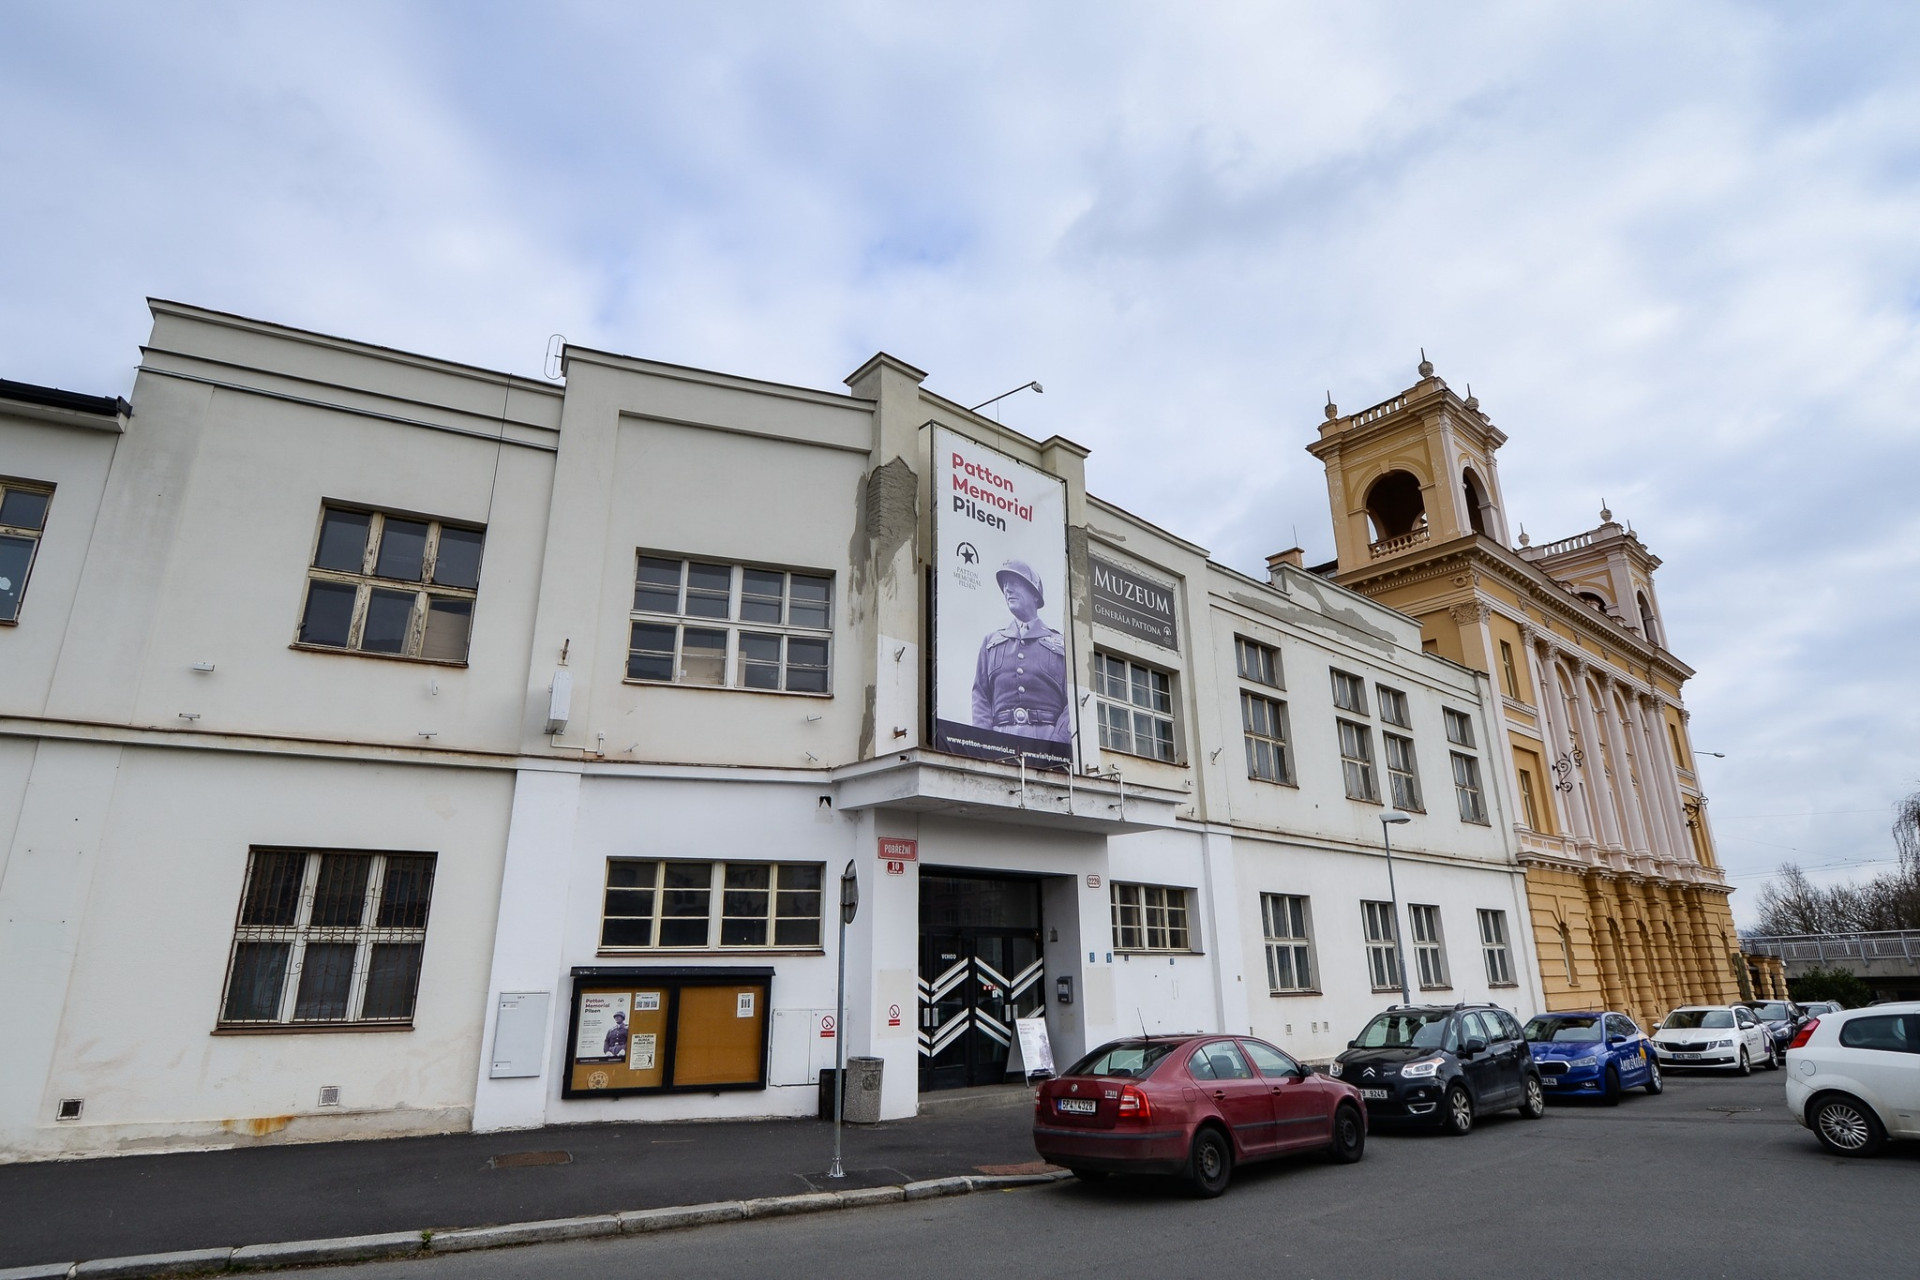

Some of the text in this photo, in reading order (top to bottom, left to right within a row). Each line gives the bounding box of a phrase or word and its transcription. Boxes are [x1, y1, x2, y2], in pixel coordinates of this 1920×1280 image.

[952, 452, 1014, 493] Patton
[952, 473, 1033, 522] Memorial
[953, 495, 1006, 532] Pilsen
[1094, 565, 1171, 615] MUZEUM
[1094, 603, 1162, 636] GENERÁLA PATTONA
[946, 735, 1016, 755] www.patton-memorial.cz
[884, 843, 911, 855] POBŘEŽNÍ
[891, 862, 900, 871] 10
[1062, 1099, 1094, 1111] 5P4 4328
